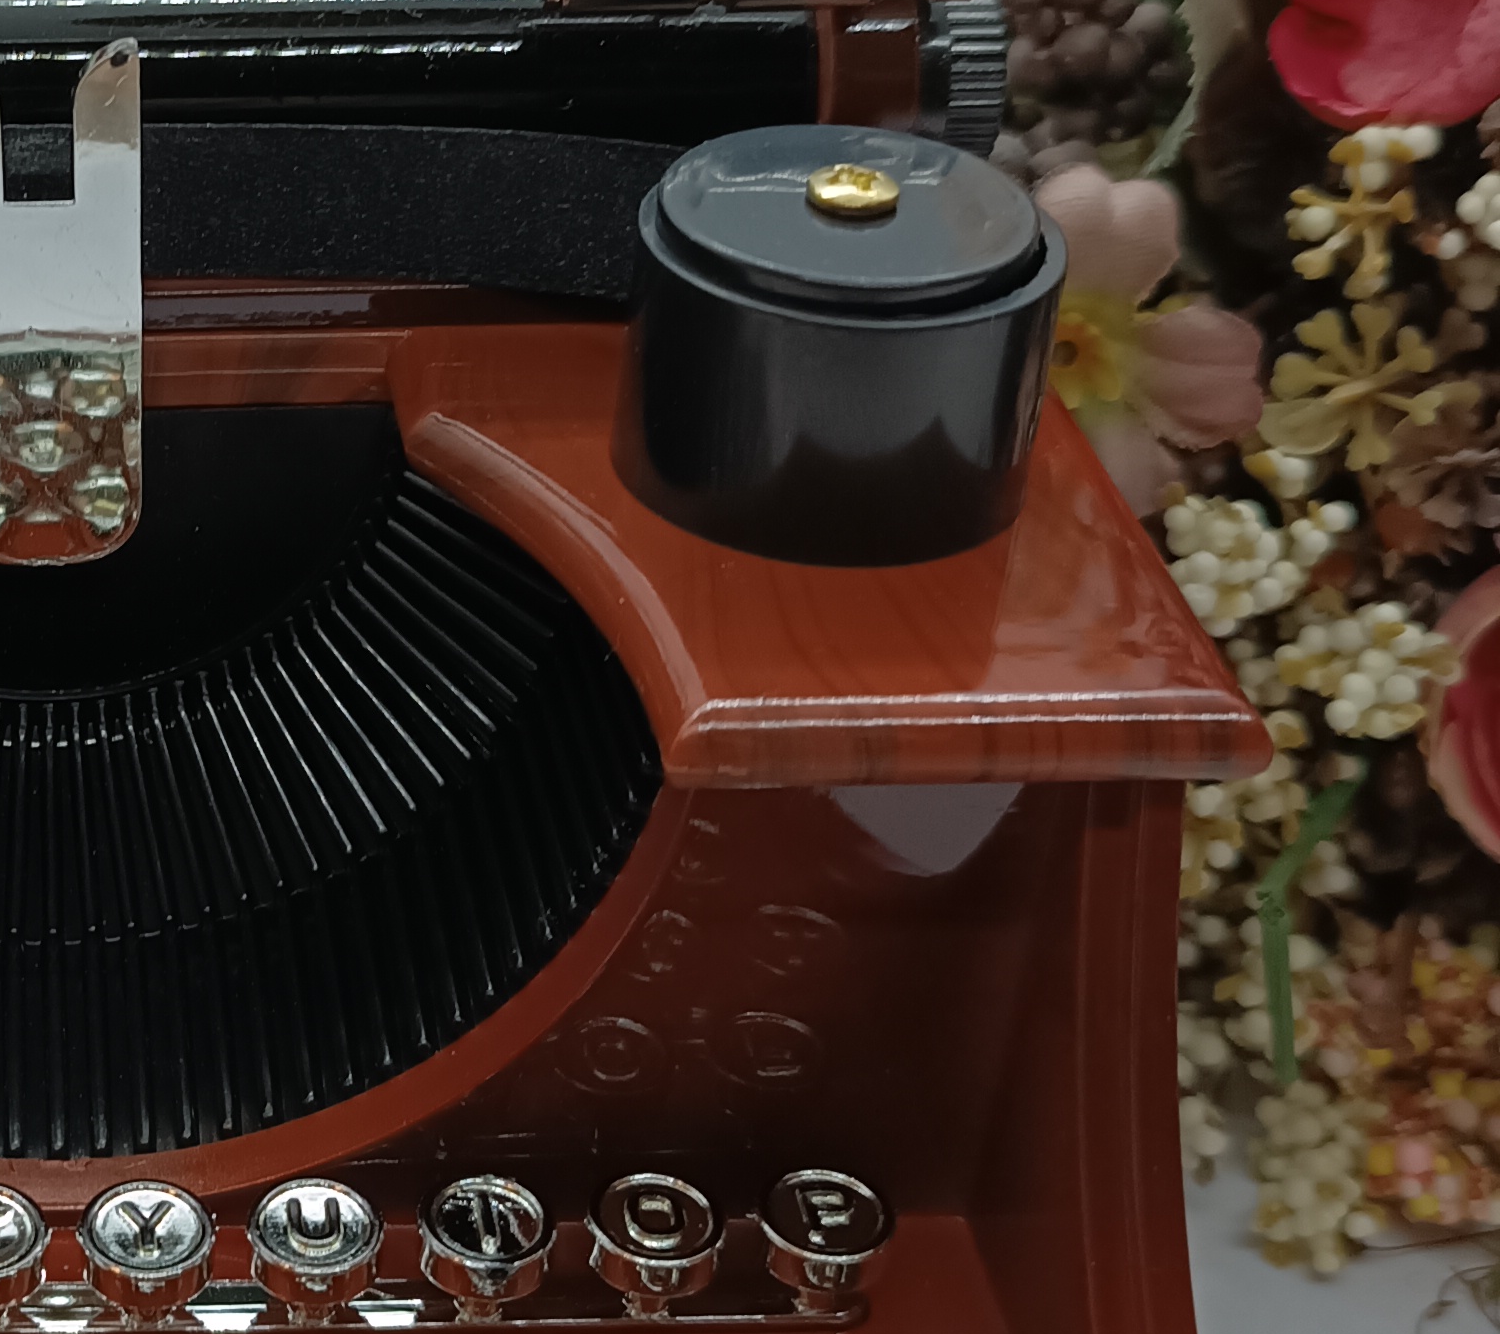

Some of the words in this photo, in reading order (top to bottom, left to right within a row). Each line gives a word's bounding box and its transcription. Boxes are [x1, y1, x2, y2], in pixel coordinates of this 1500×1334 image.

[116, 1199, 169, 1258] Y
[285, 1196, 343, 1252] U
[621, 1192, 685, 1251] O
[793, 1186, 857, 1246] P
